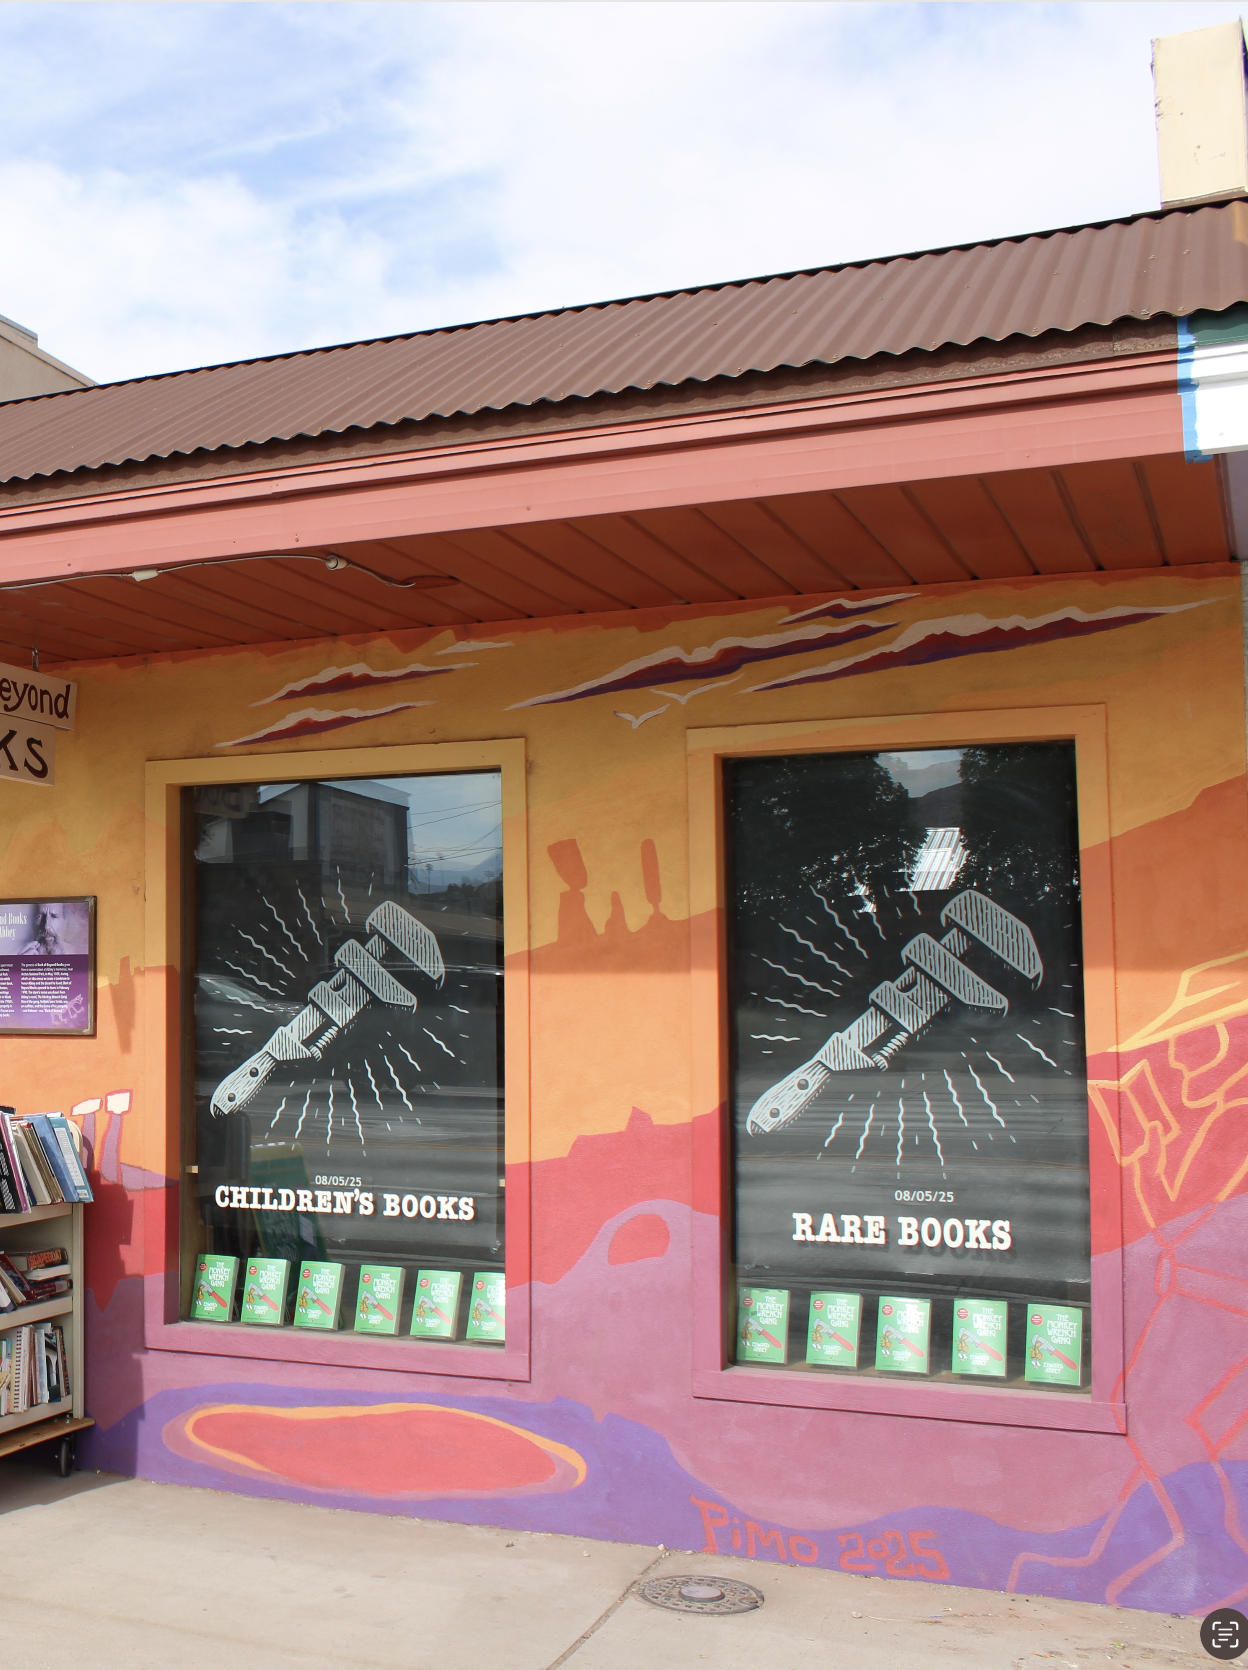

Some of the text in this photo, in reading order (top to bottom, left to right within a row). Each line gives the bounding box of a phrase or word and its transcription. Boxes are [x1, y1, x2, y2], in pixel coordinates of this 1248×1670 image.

[8, 912, 28, 925] Books
[314, 1174, 362, 1188] 08/05/25
[894, 1189, 955, 1203] 08/05/25
[214, 1184, 476, 1221] CHILDREN'S BOOKS
[792, 1212, 1012, 1251] RARE BOOKS
[757, 1302, 784, 1311] MONKEY
[827, 1305, 855, 1313] MONKEY
[760, 1317, 777, 1325] GANG
[831, 1320, 848, 1328] GANG
[1047, 1320, 1078, 1330] MONKEY
[1047, 1328, 1077, 1338] WRENCH
[1051, 1336, 1071, 1345] GANG
[837, 1529, 952, 1581] 2025
